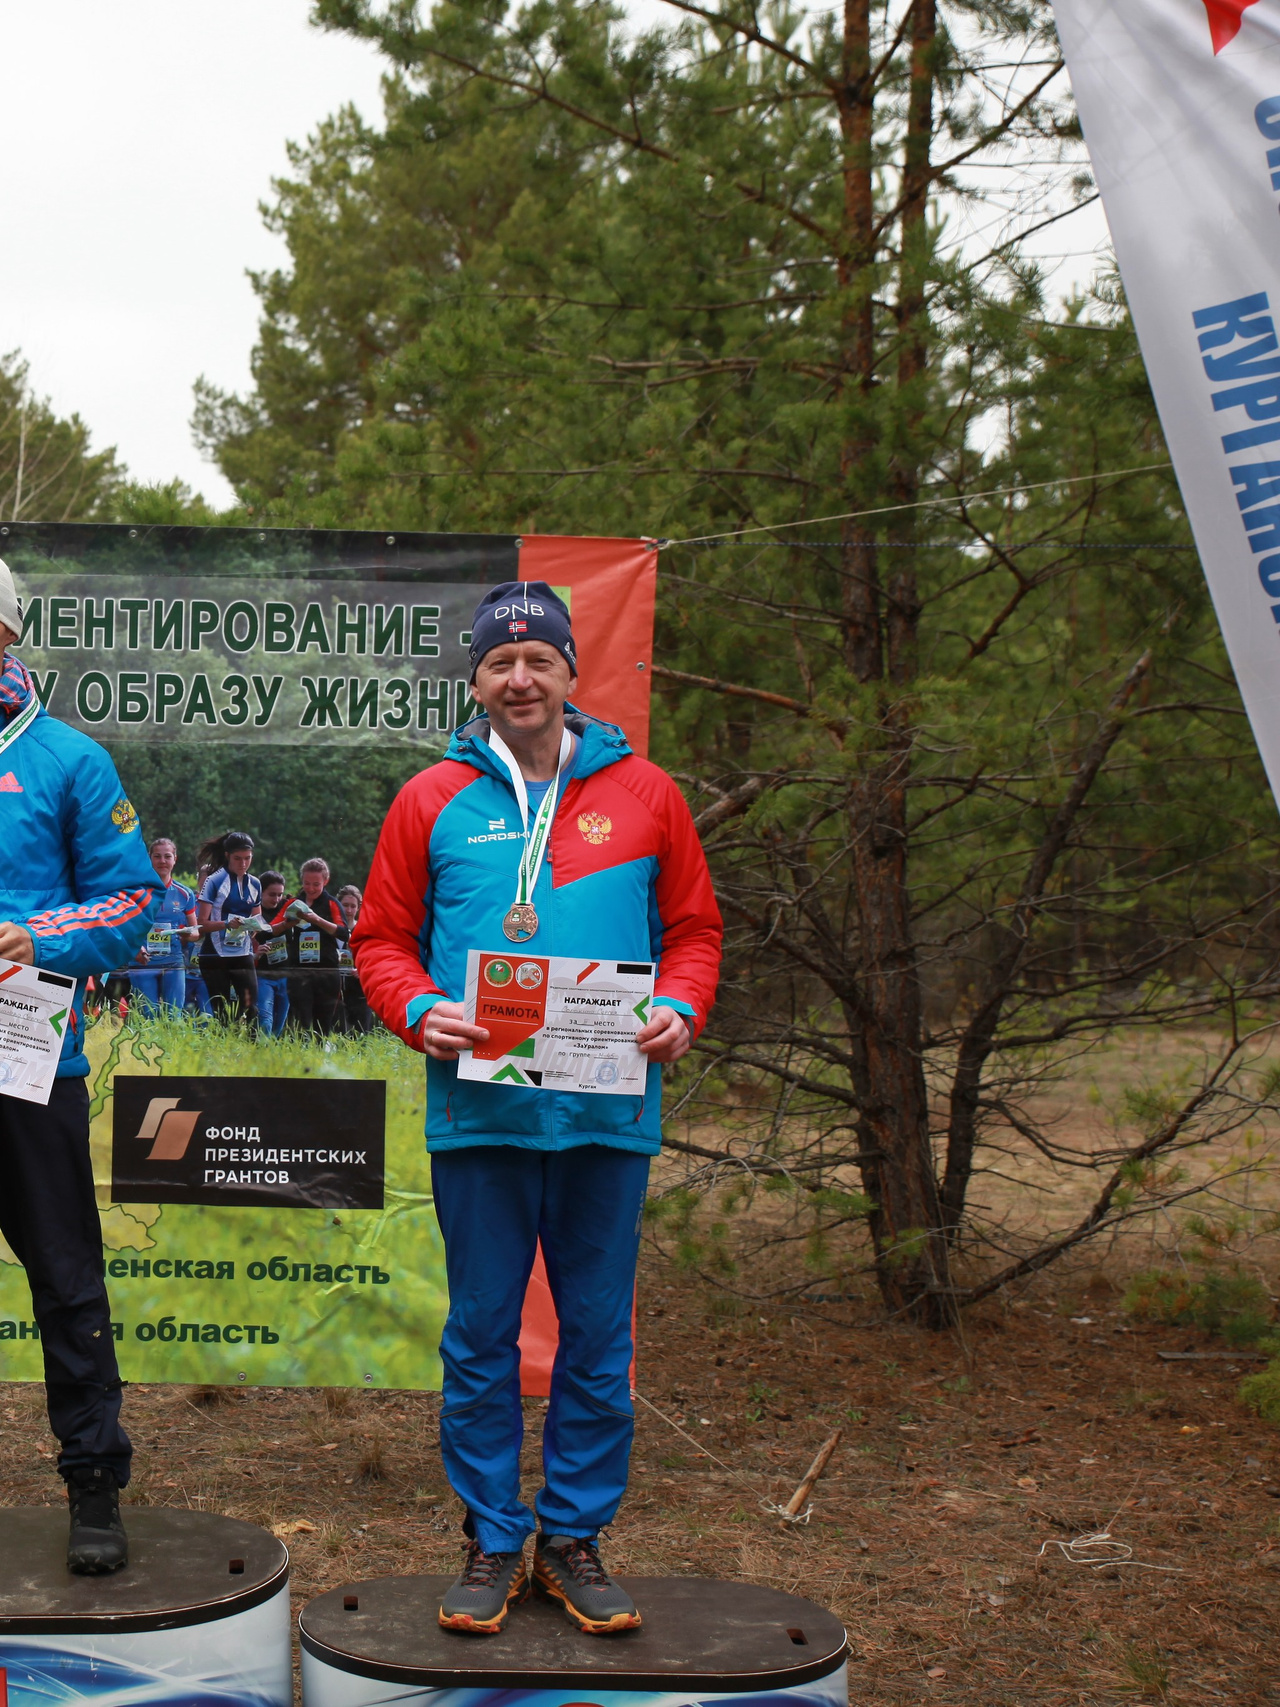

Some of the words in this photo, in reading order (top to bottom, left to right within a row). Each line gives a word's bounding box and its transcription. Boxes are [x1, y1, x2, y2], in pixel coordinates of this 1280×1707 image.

[1192, 291, 1280, 625] КУРГАН
[495, 601, 544, 620] DNB
[14, 597, 441, 659] ИЕНТИРОВАНИЕ
[76, 671, 284, 728] ОБРАЗУ
[300, 675, 476, 732] ЖИЗНИ
[564, 997, 621, 1006] НАГРАЖДАЕТ
[482, 1004, 539, 1019] ГРАМОТА
[205, 1126, 261, 1144] ФОНД
[204, 1147, 366, 1165] ПРЕЗИДЕНТСКИХ
[204, 1169, 290, 1185] ГРАНТОВ
[104, 1259, 235, 1280] енская
[246, 1256, 391, 1285] область
[135, 1316, 280, 1344] область
